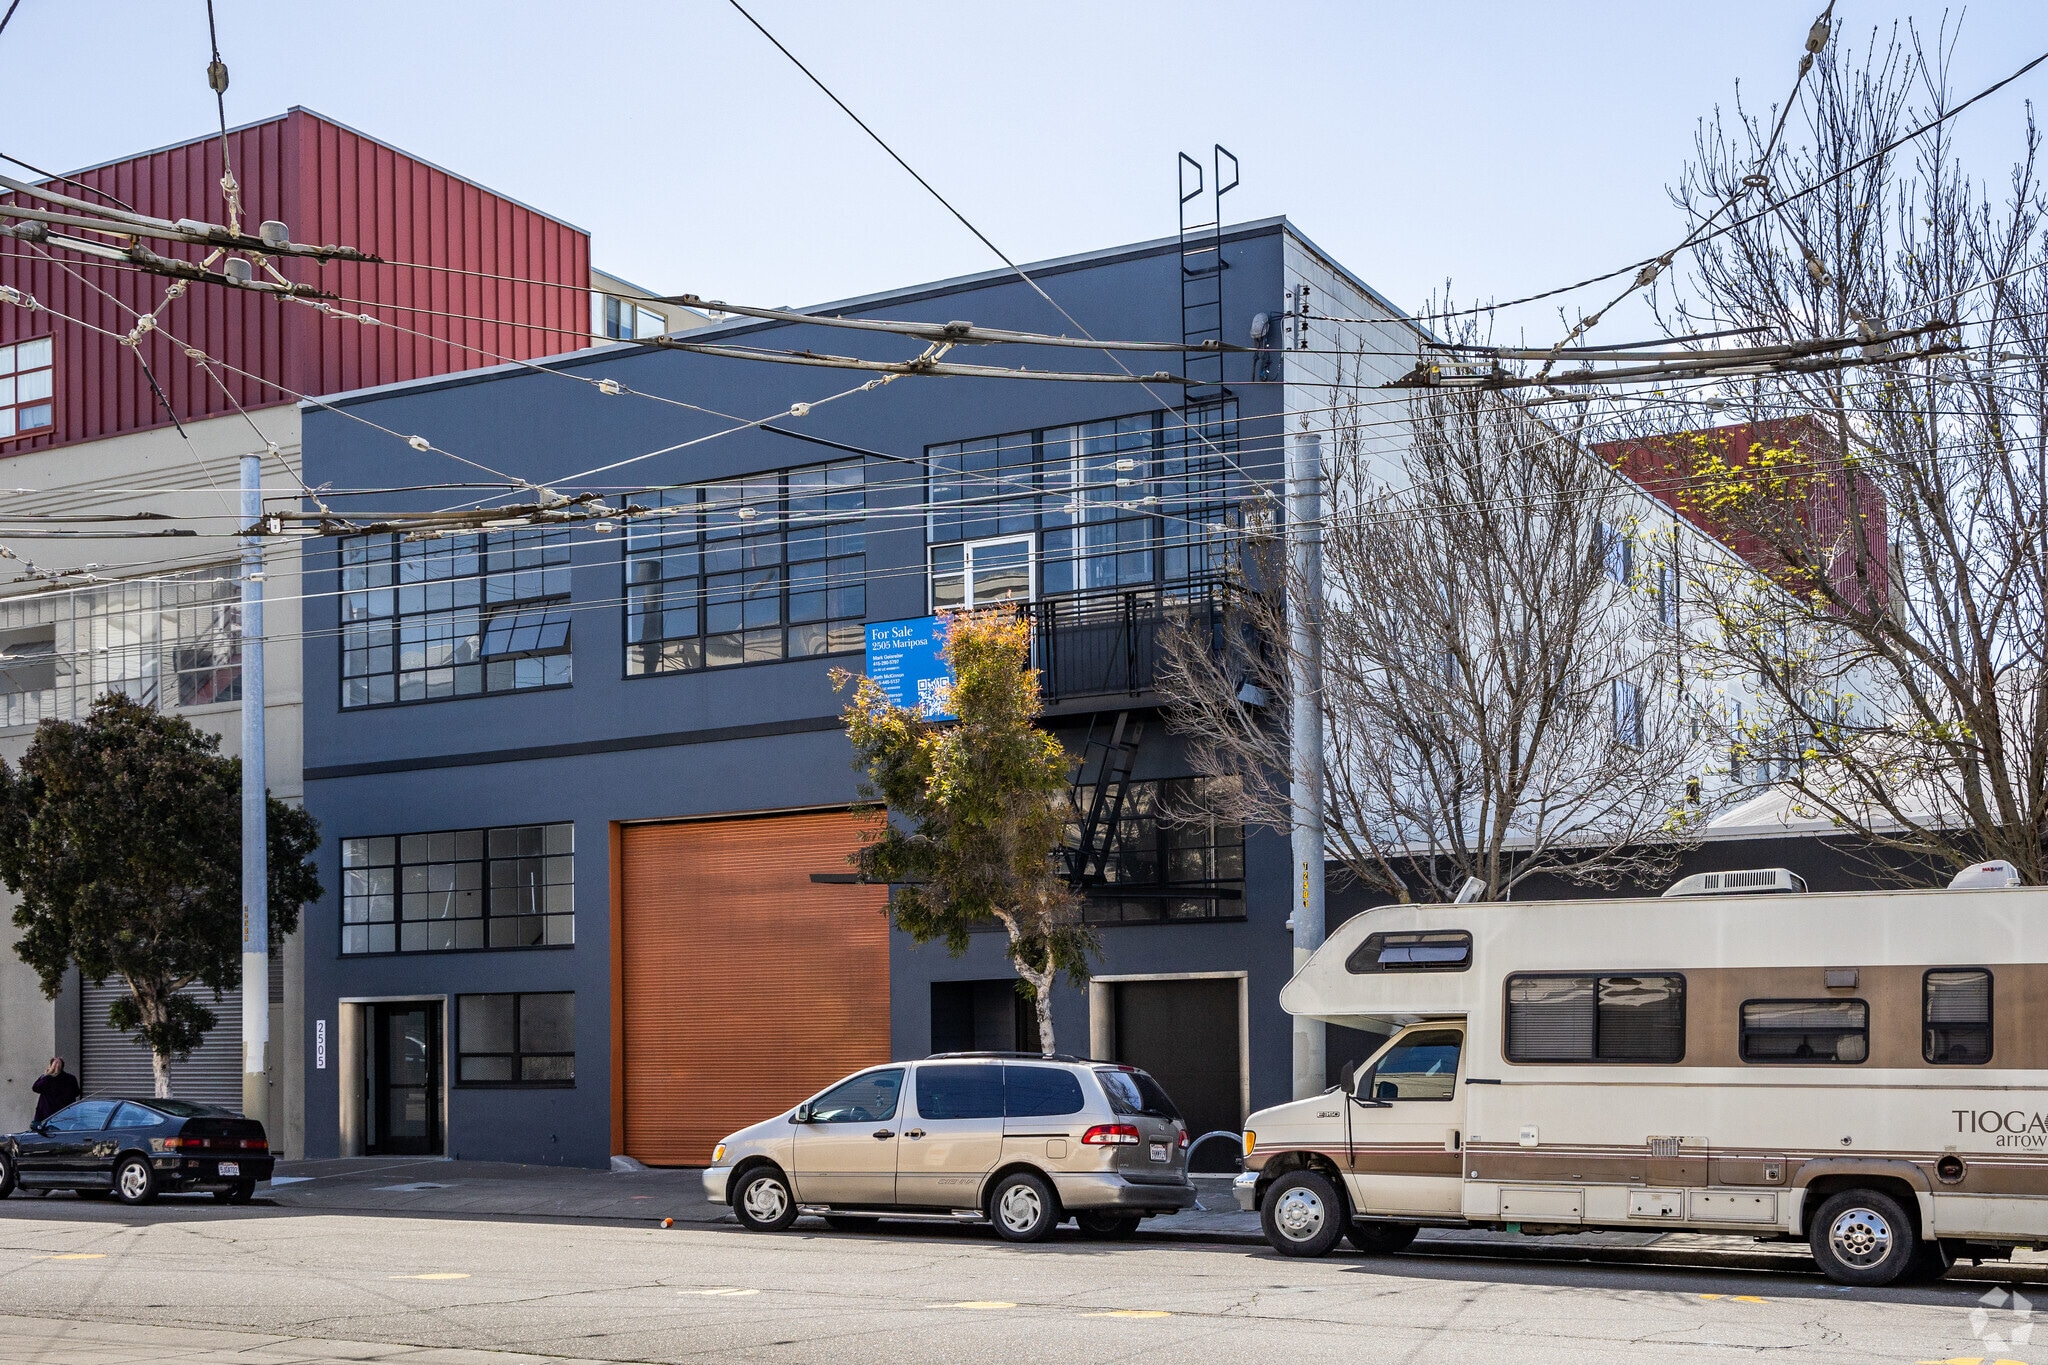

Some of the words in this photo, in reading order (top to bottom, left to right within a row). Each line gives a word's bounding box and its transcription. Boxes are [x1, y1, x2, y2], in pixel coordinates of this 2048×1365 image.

[872, 628, 889, 640] For
[891, 625, 913, 638] Sale
[872, 640, 891, 651] 2505
[892, 638, 928, 650] Mariposa
[1951, 1110, 2047, 1134] TIOGA
[1996, 1134, 2048, 1148] arrow
